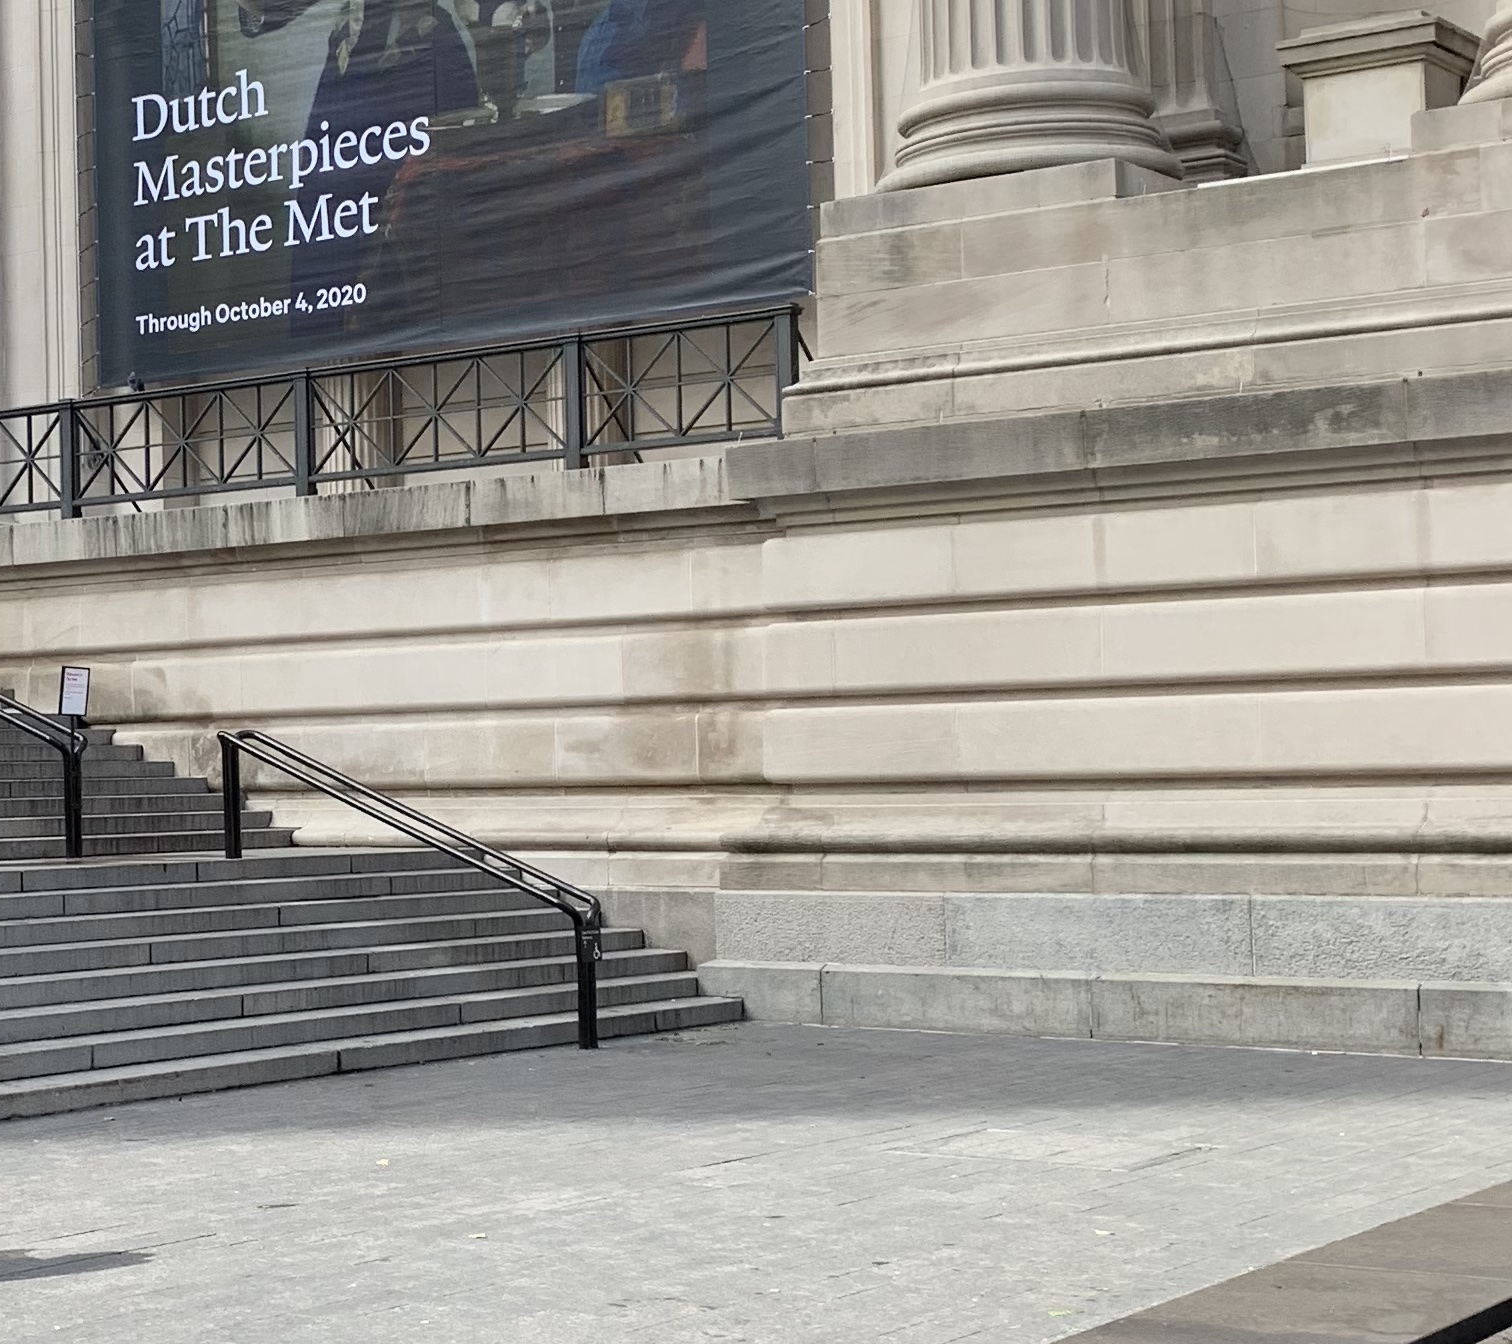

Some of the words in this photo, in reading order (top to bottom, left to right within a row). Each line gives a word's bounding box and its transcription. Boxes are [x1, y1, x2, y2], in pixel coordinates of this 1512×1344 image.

[131, 68, 268, 142] Dutch
[133, 116, 431, 206] Masterpieces
[135, 225, 176, 271] at
[185, 206, 273, 262] The
[283, 191, 379, 247] Met
[136, 306, 212, 335] Through
[215, 296, 291, 325] October
[294, 292, 314, 314] 4,
[316, 283, 367, 310] 2020
